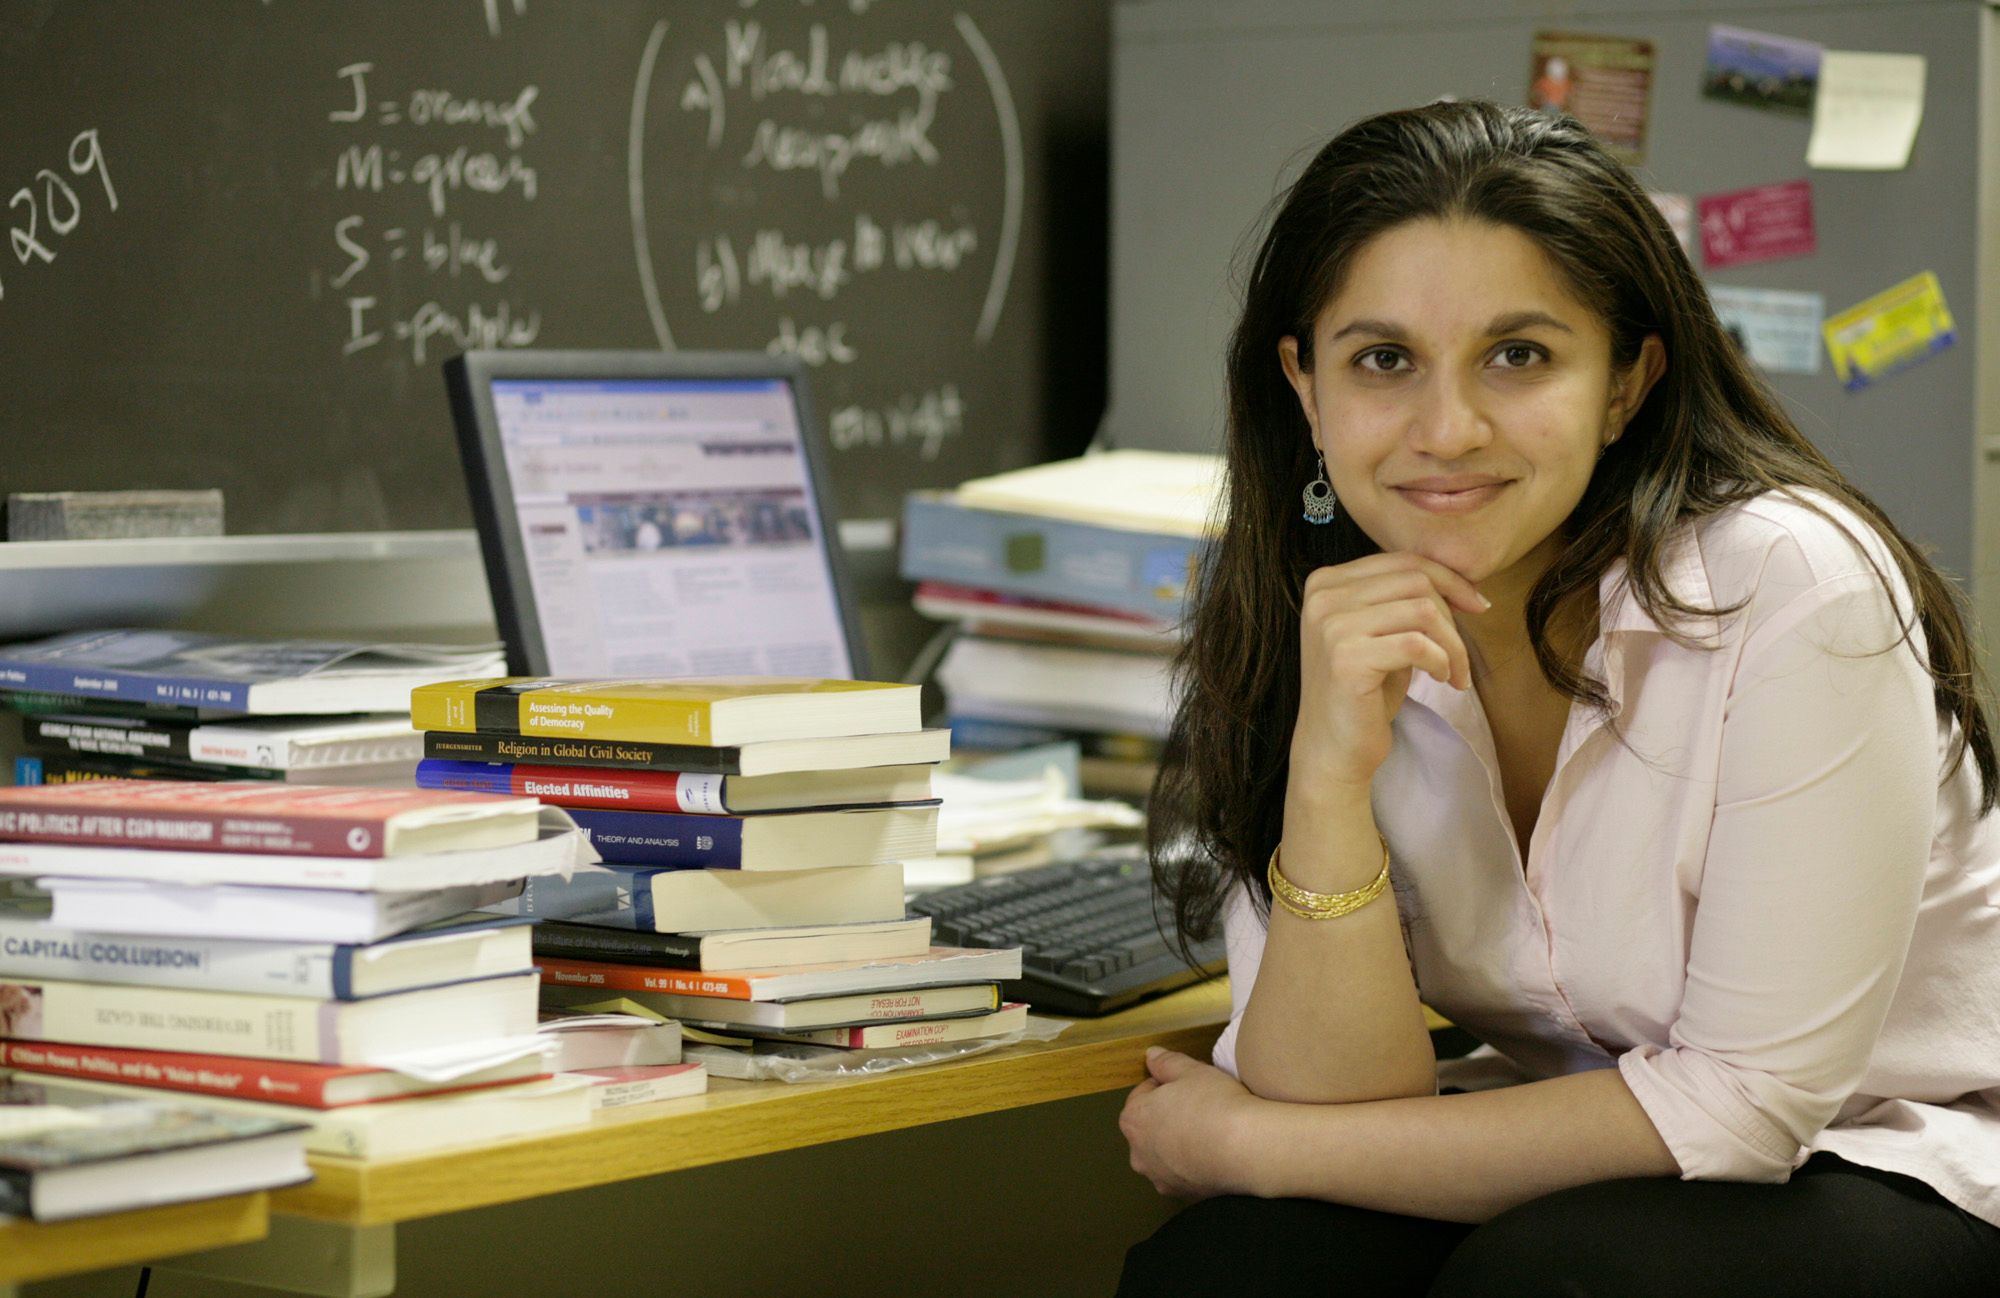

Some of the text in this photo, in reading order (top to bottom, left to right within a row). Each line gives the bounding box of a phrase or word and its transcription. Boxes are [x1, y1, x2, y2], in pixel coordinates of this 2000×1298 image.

[9, 128, 119, 265] 209
[423, 222, 513, 283] blue
[529, 702, 614, 718] Assessing the Quality
[529, 717, 585, 731] of Democracy
[498, 741, 538, 758] Religion
[541, 745, 551, 756] in
[553, 743, 586, 758] Global
[589, 746, 613, 760] Civil
[616, 747, 653, 765] Society
[525, 781, 630, 800] Elected Affinities
[18, 814, 79, 836] POLITICS
[81, 816, 124, 838] AFTER
[597, 834, 626, 845] THEORY
[627, 836, 643, 846] AND
[644, 837, 680, 848] ANALYSIS
[4, 937, 200, 967] CAPITAL COLLUSION
[555, 971, 589, 984] November
[644, 977, 657, 988] Vol.
[658, 978, 667, 989] 99
[675, 980, 688, 991] No.
[871, 996, 921, 1009] NOT FOR RESALE
[896, 1025, 933, 1040] EXAMINATION
[121, 1060, 142, 1077] and
